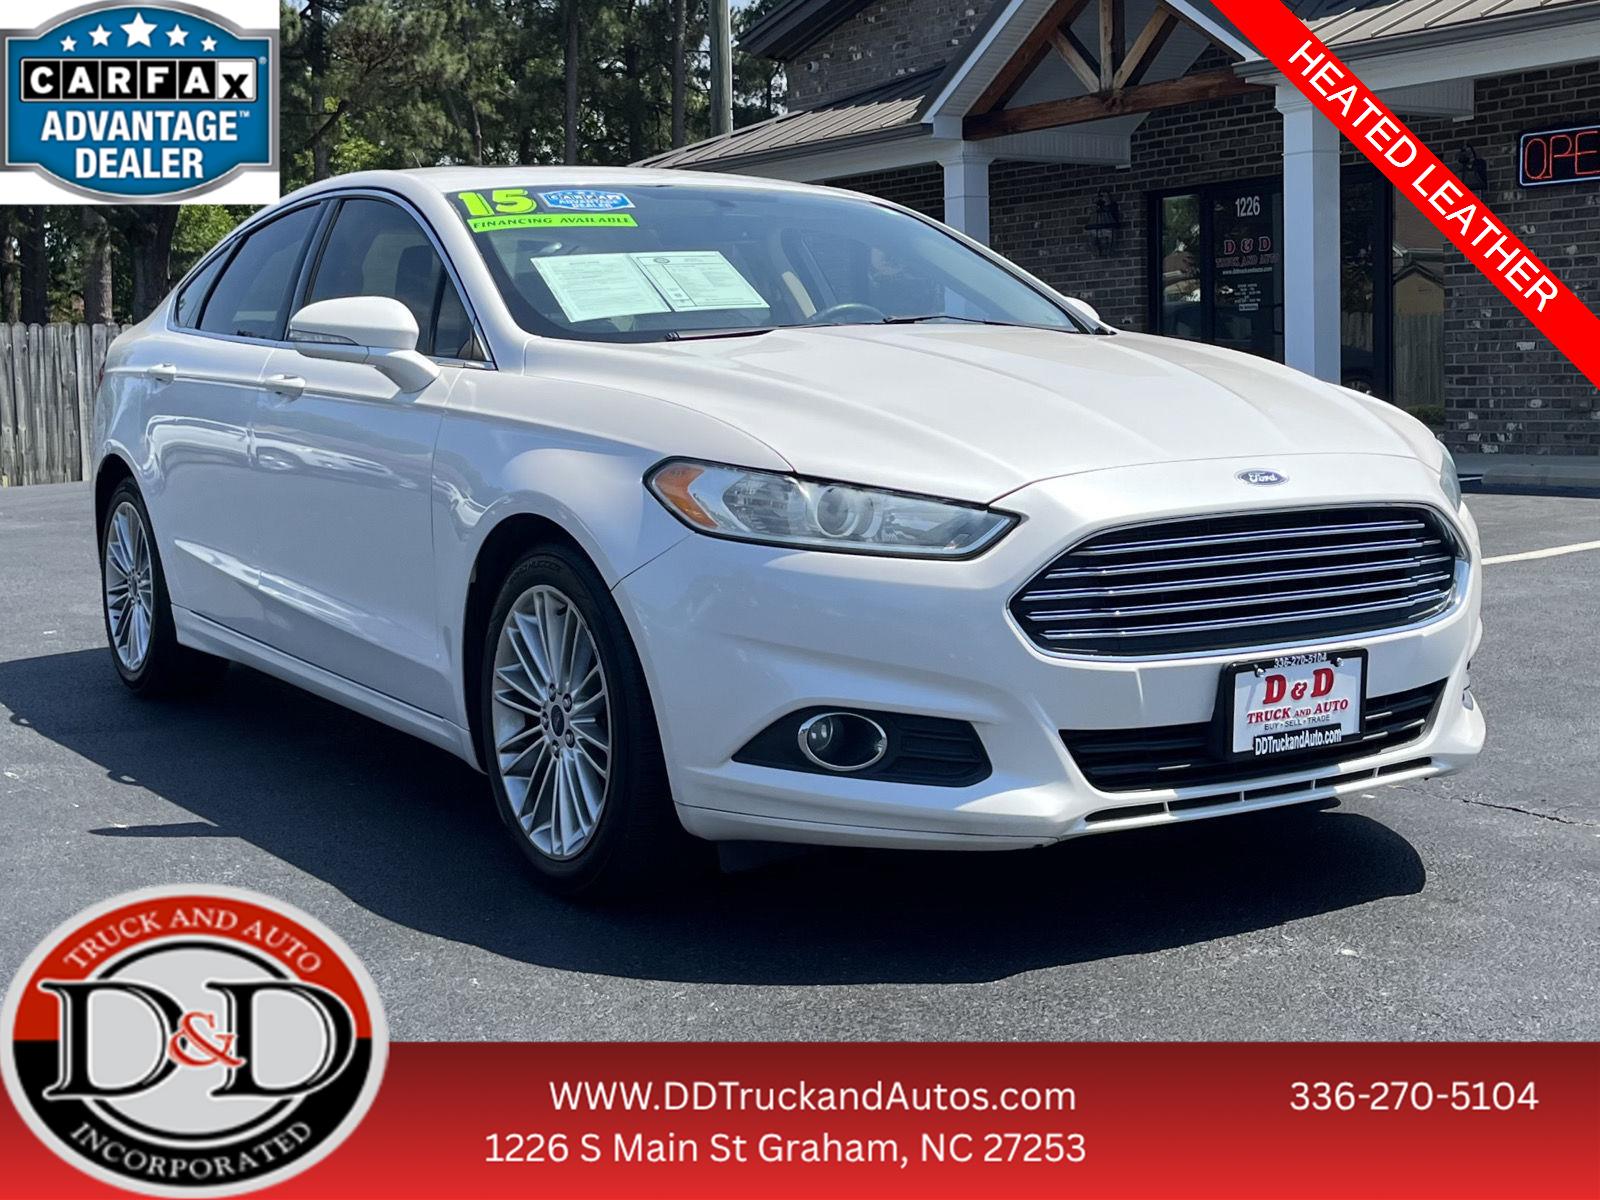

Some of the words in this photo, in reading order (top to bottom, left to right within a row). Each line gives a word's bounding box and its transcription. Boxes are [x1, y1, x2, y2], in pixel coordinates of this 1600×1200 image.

[458, 189, 538, 216] 15
[1235, 196, 1260, 217] 1226
[473, 217, 552, 229] FINANCING
[560, 216, 631, 224] AVAILABLE
[1248, 472, 1278, 483] Ford
[1247, 708, 1291, 724] TRUCK
[1294, 709, 1312, 718] AND
[1313, 699, 1349, 714] AUTO
[1264, 722, 1280, 731] BUY
[1284, 719, 1302, 728] SELL
[1307, 714, 1330, 724] TRADE
[1255, 728, 1341, 755] DDTruckandAuto.com
